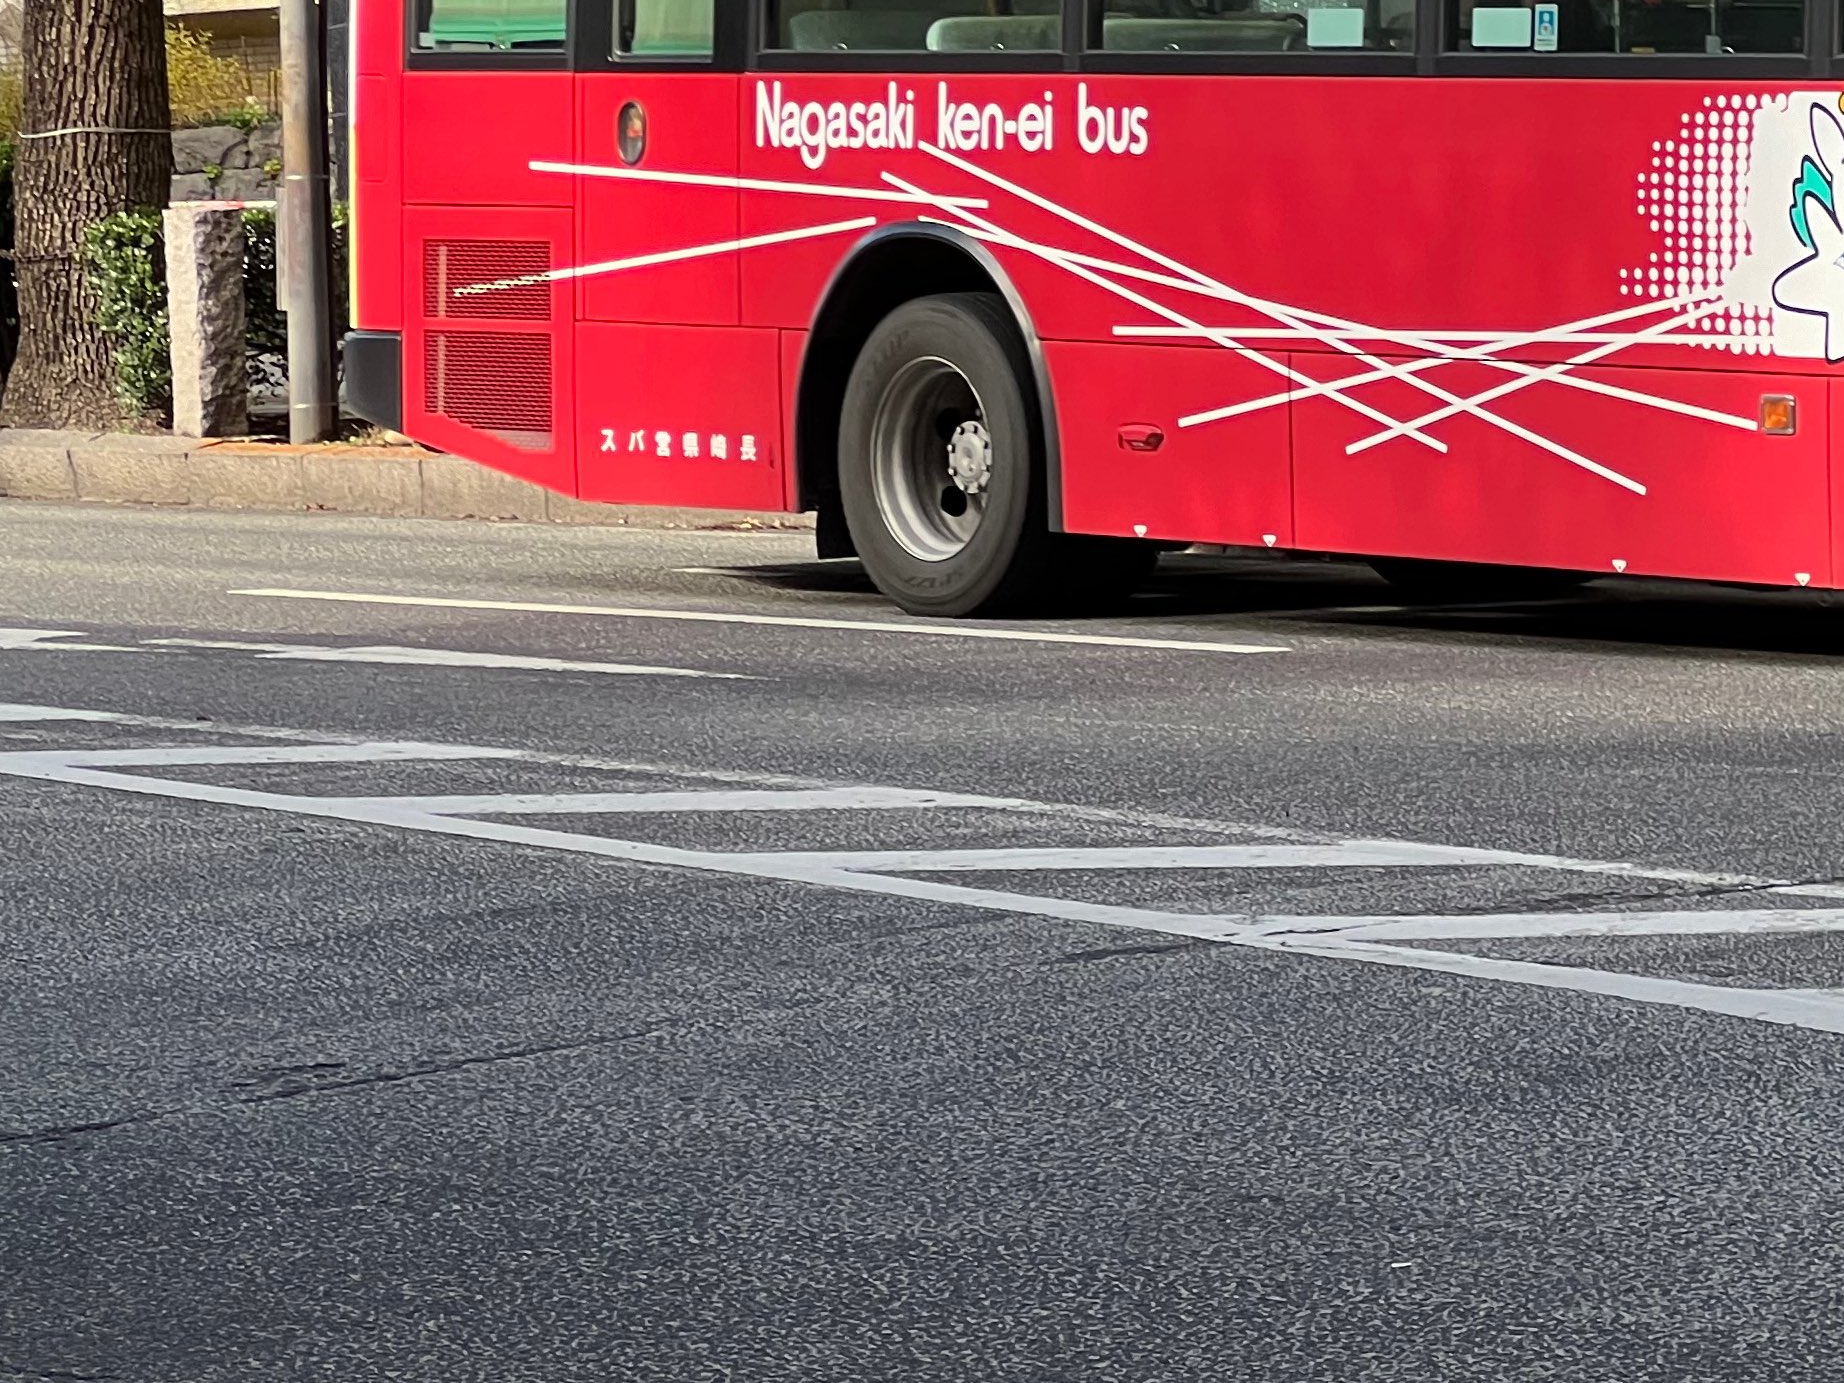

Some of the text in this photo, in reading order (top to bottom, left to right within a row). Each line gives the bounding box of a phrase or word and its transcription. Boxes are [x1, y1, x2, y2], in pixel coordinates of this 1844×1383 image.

[755, 79, 1150, 171] Nagasaki ken-ei bus
